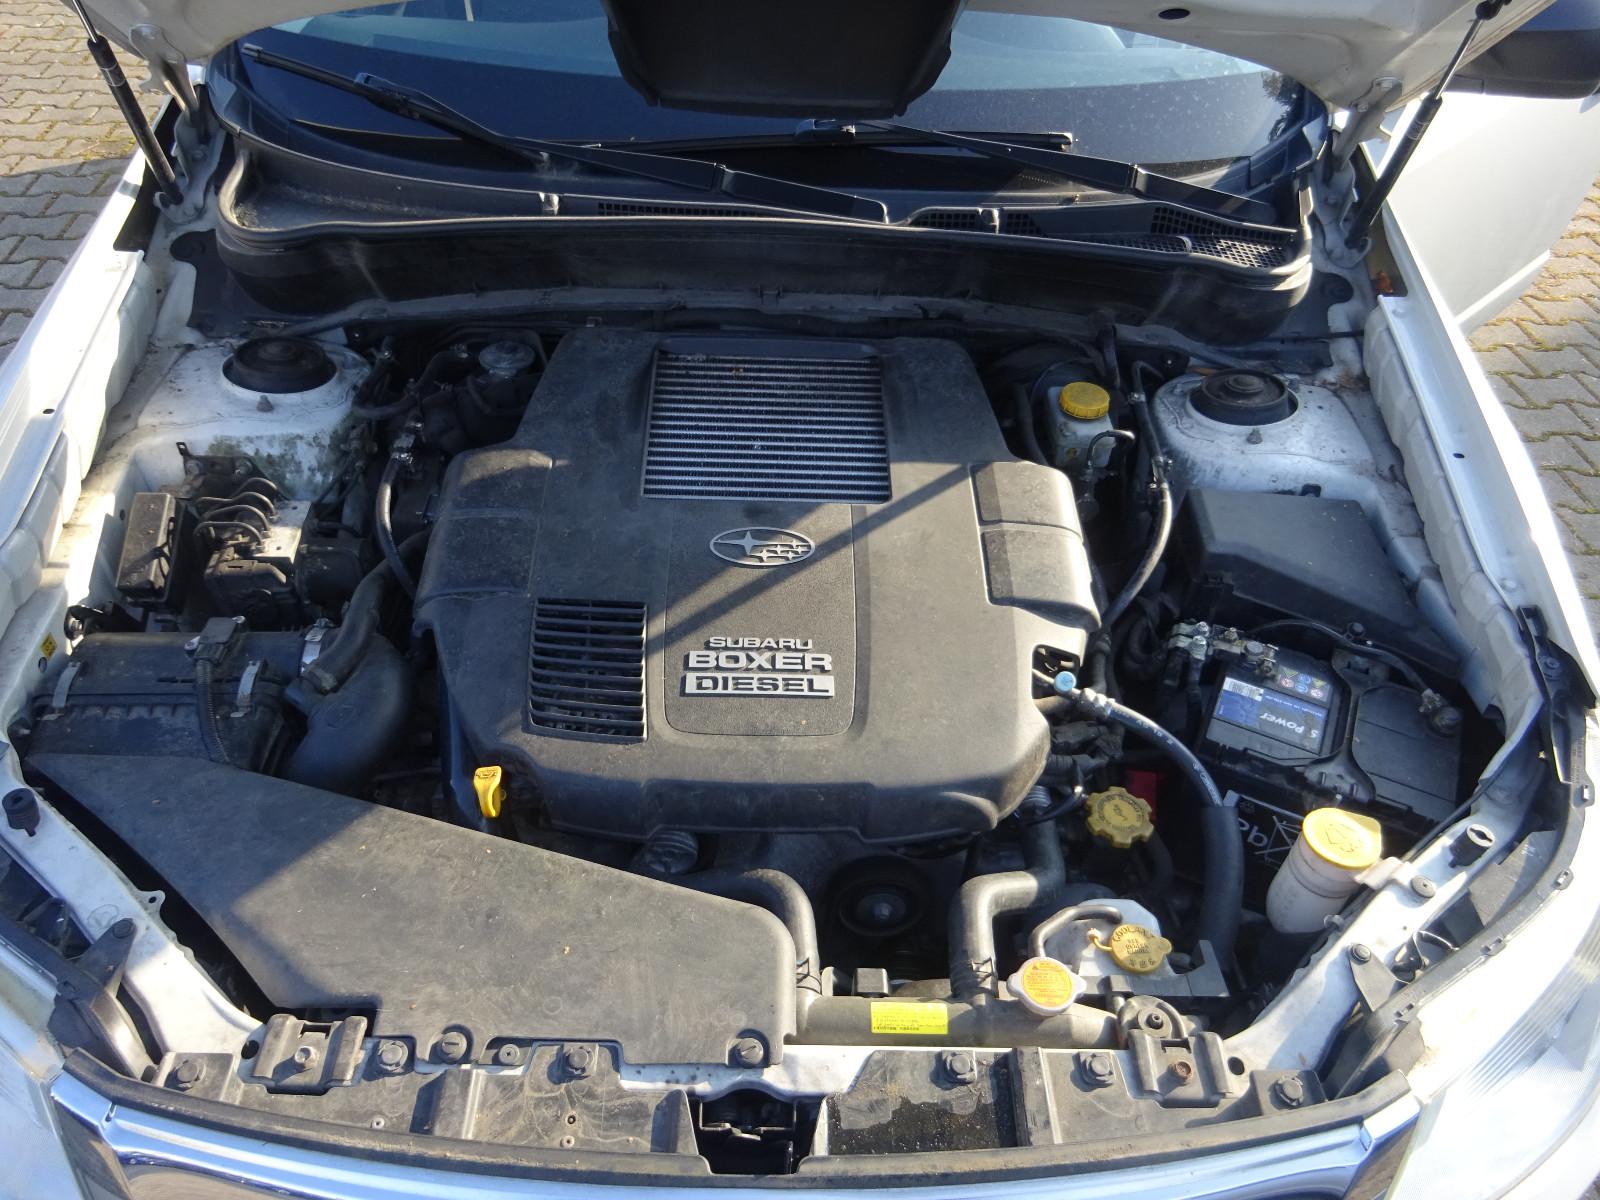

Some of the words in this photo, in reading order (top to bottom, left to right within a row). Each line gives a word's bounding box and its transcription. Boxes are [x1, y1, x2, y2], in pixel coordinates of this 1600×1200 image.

[709, 637, 813, 649] SUBARU
[688, 650, 833, 670] BOXER
[695, 675, 830, 693] DIESEL
[1259, 712, 1305, 734] Power
